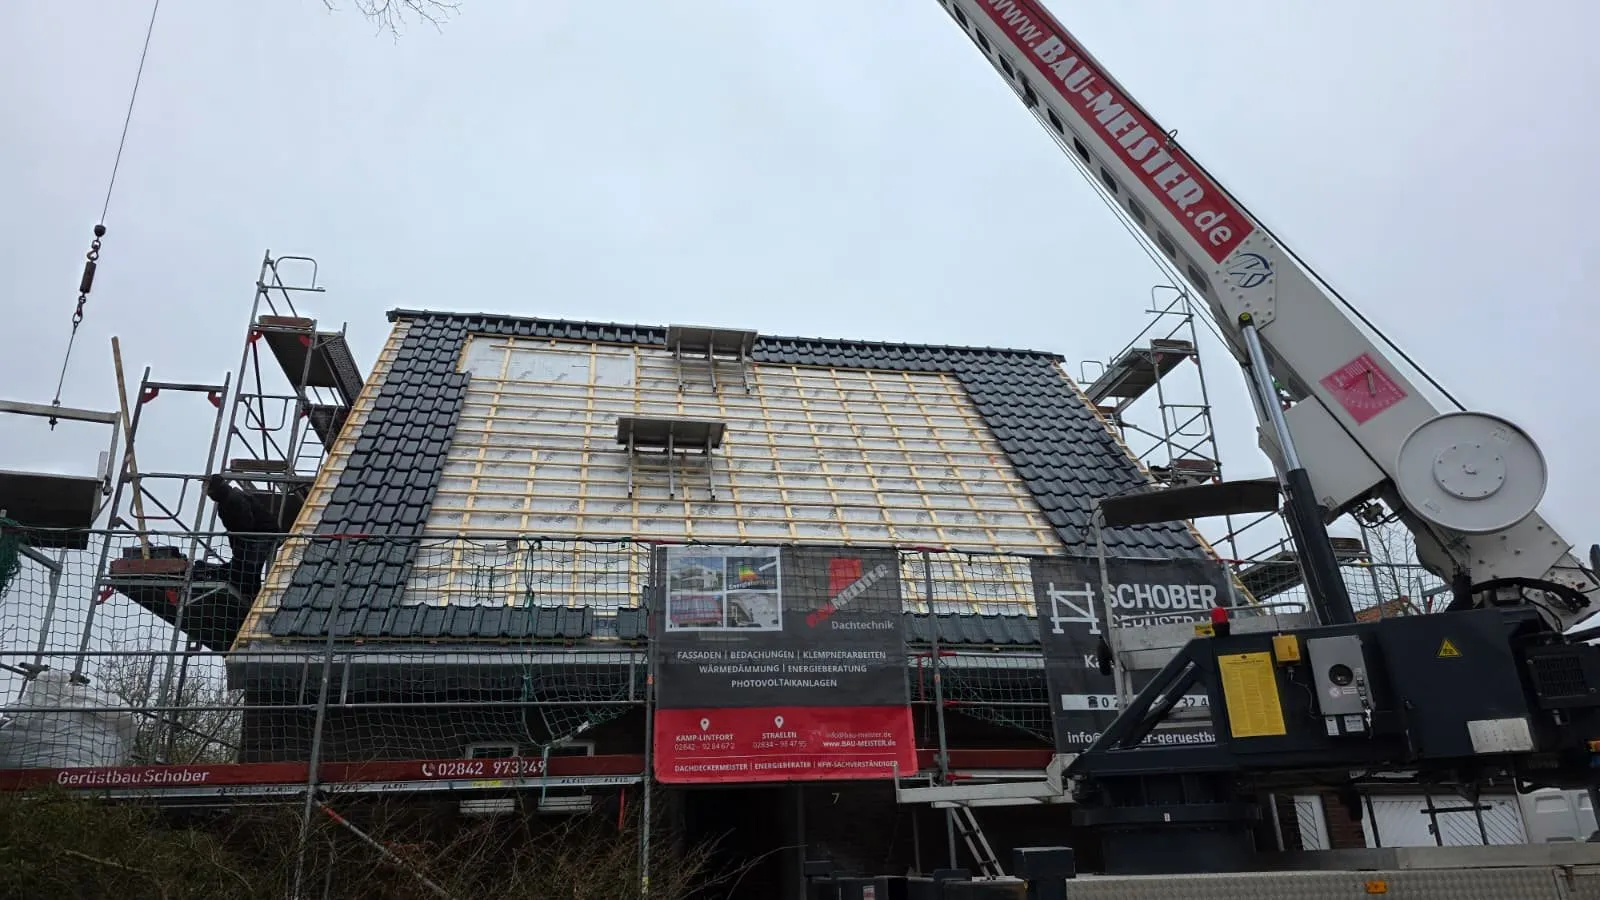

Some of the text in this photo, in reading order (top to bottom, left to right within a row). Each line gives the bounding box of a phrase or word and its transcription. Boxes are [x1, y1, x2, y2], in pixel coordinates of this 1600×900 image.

[1104, 583, 1217, 609] SCHOBER
[832, 620, 894, 629] Dachtechnik
[677, 650, 886, 659] FASSADEN BEDACHUNGEN KLEMPNERARBEITEN
[699, 664, 867, 673] WÄRMEDÄMMUNG ENERGIEBERATUNG
[731, 678, 837, 687] PHOTOVOLTAIKANLAGEN
[762, 731, 797, 739] STRAELEN
[438, 760, 546, 776] 02842 973249
[675, 764, 748, 772] DACHDECKERMEISTER
[755, 761, 811, 770] ENERGIEBERATER
[57, 769, 209, 785] Gerüstbau Schober
[831, 792, 840, 804] 7
